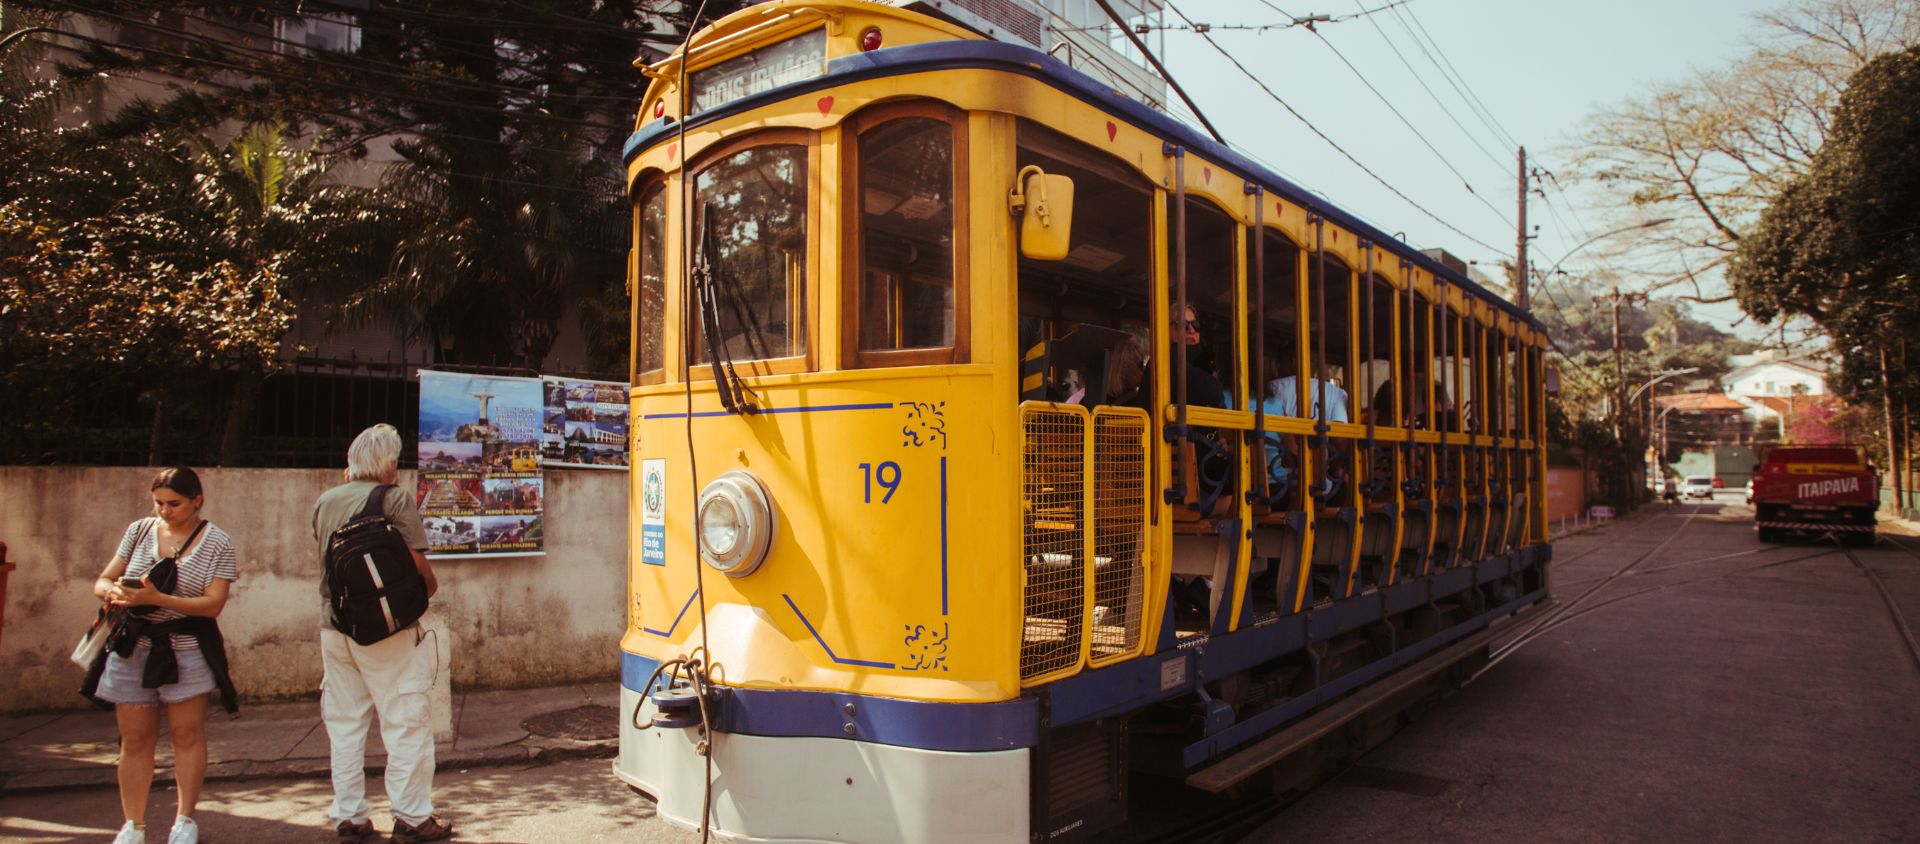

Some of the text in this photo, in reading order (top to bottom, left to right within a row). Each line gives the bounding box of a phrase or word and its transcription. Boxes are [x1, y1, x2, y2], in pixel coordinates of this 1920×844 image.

[705, 76, 745, 106] DOIS
[858, 461, 902, 504] 19
[1798, 477, 1859, 499] ITAIPAVA
[643, 547, 664, 559] Janeiro
